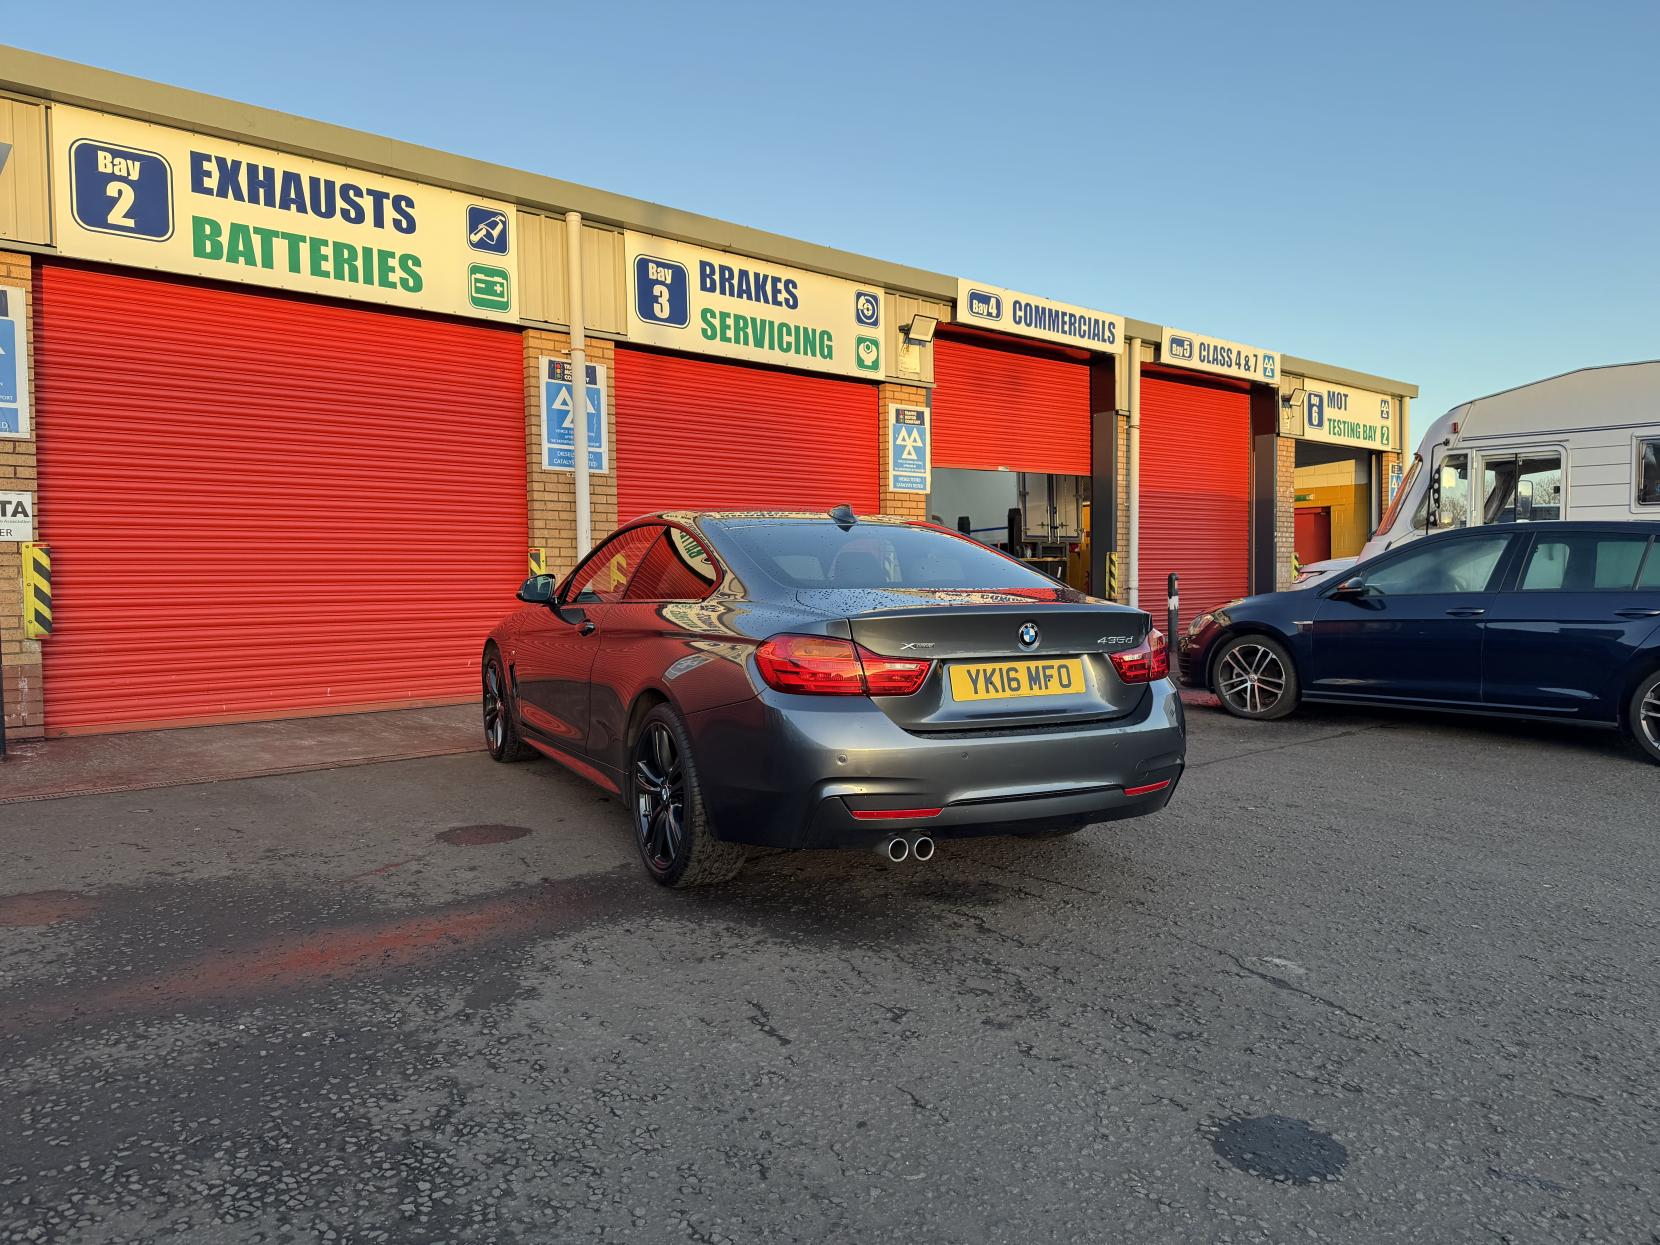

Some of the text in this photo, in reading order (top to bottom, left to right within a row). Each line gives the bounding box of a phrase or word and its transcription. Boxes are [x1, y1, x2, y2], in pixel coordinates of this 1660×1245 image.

[97, 150, 141, 180] Bay
[106, 181, 136, 228] 2
[189, 150, 416, 236] EXHAUSTS
[191, 214, 424, 294] BATTERIES
[648, 261, 673, 285] Bay
[699, 259, 799, 311] BRAKES
[652, 284, 671, 320] 3
[700, 307, 834, 361] SERVICING
[1012, 299, 1116, 345] COMMERCIALS
[1199, 341, 1259, 373] CLASS 4 & 7
[1311, 405, 1319, 426] 6
[1327, 390, 1349, 411] MOT
[1327, 417, 1390, 445] TESTING BAY 2
[1097, 635, 1134, 645] 435d
[966, 663, 1072, 695] YK16 MFO
